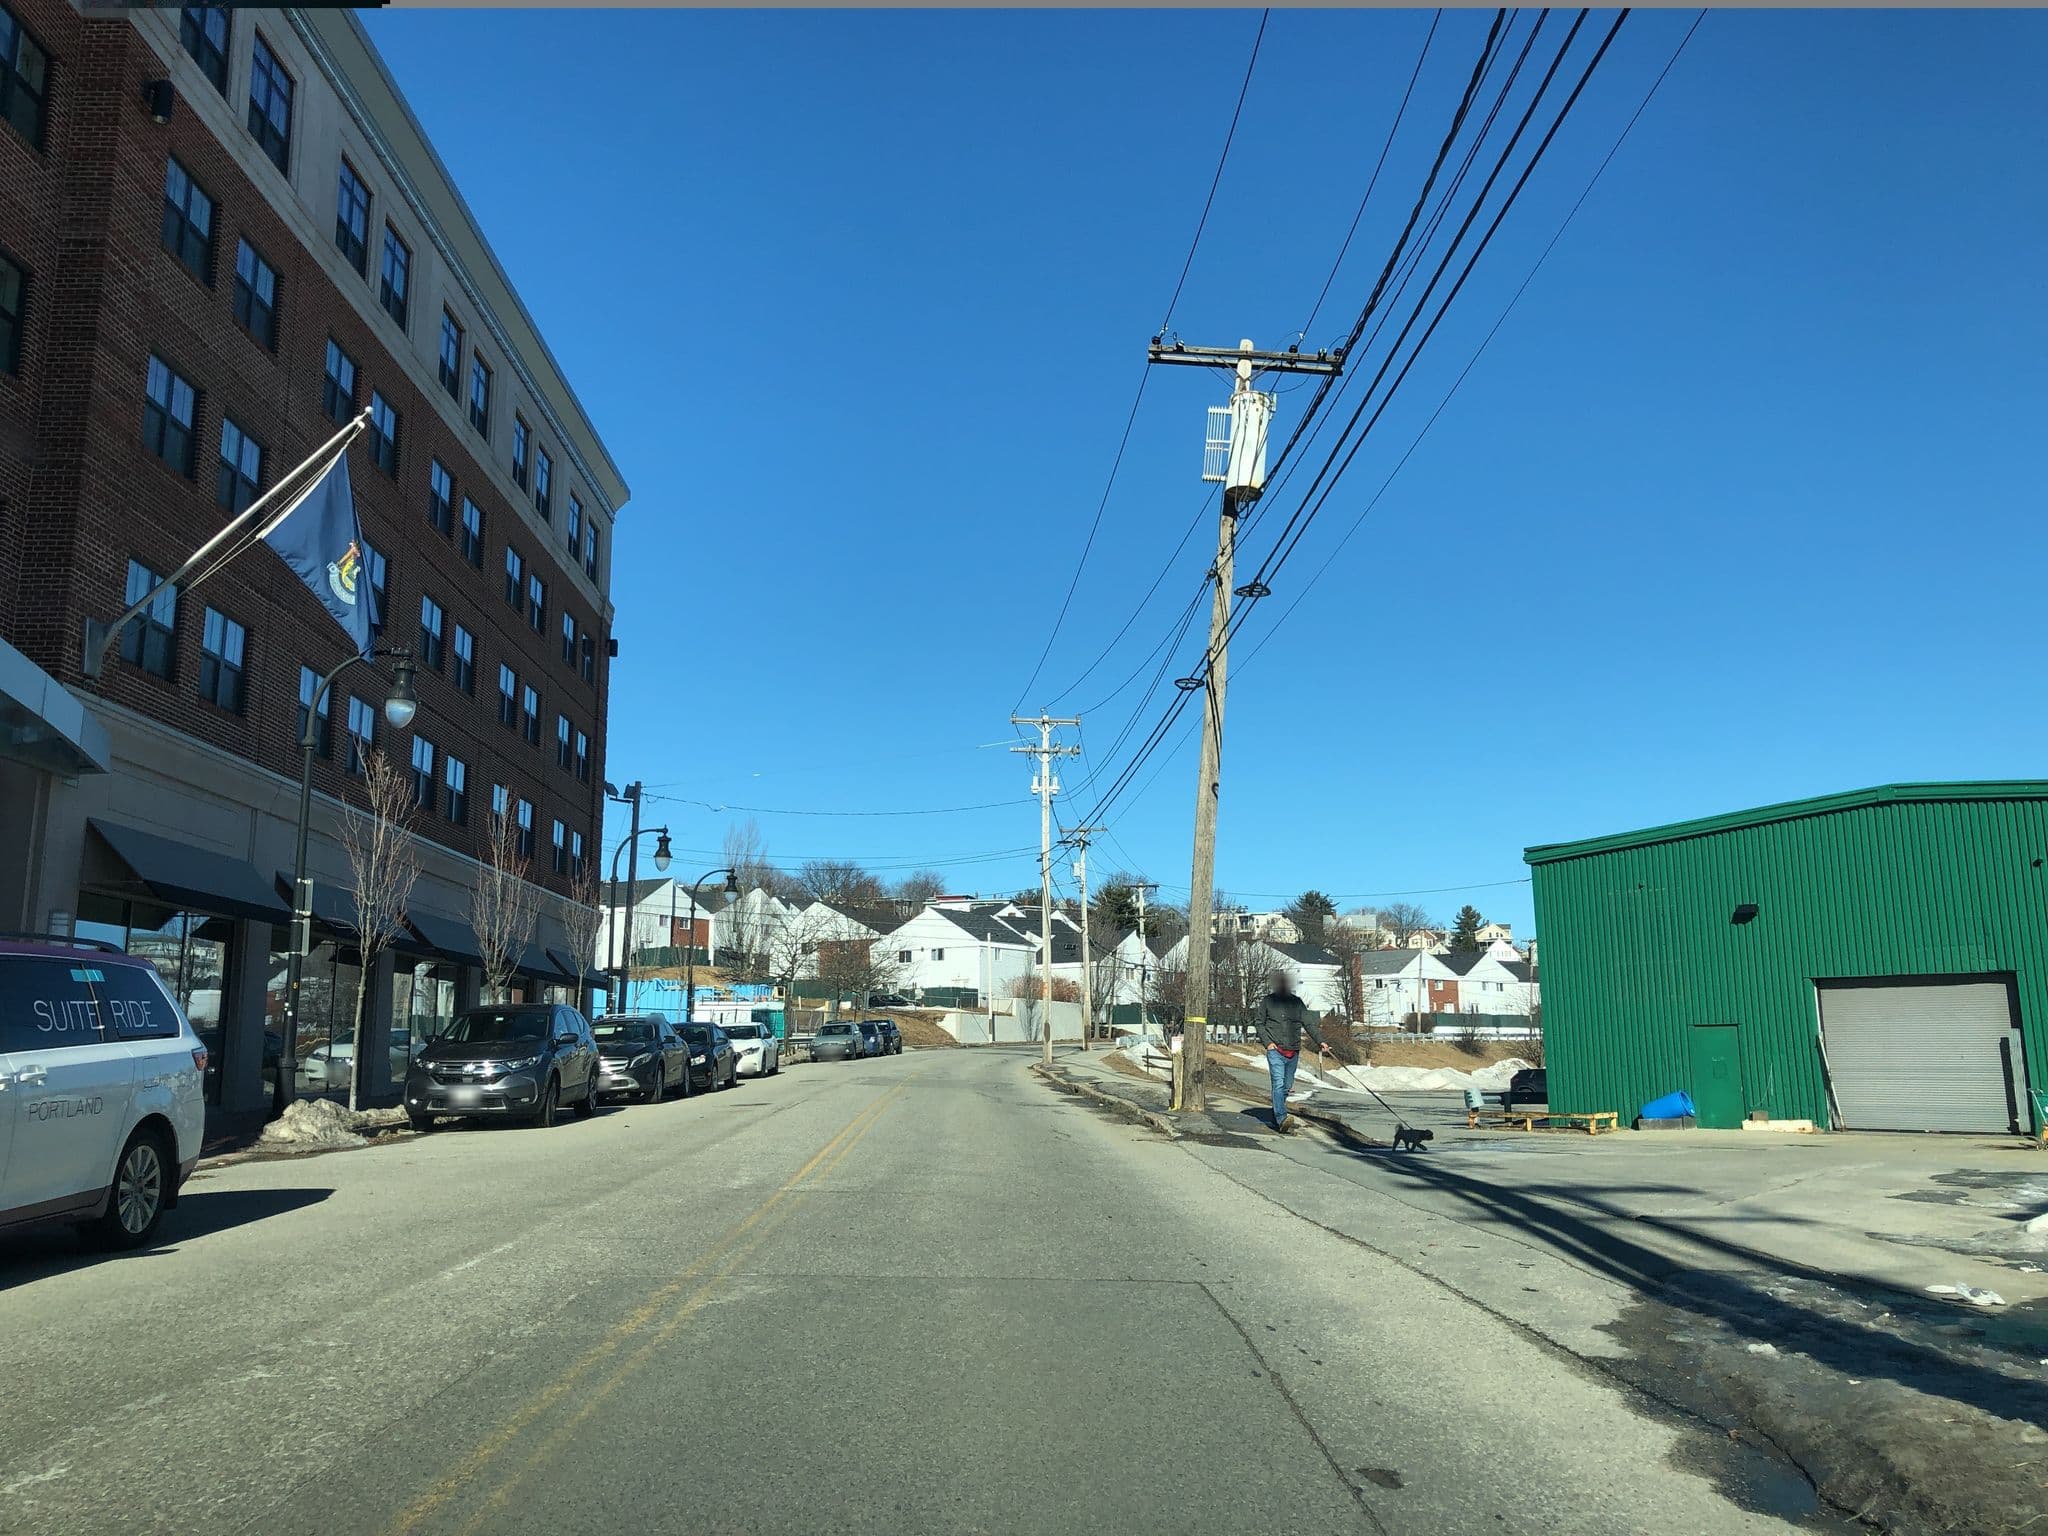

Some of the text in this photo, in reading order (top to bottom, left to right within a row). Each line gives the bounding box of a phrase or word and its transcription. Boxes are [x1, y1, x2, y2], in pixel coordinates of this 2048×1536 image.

[34, 1000, 158, 1032] SUITE RIDE
[29, 1097, 103, 1122] PORTLAND
